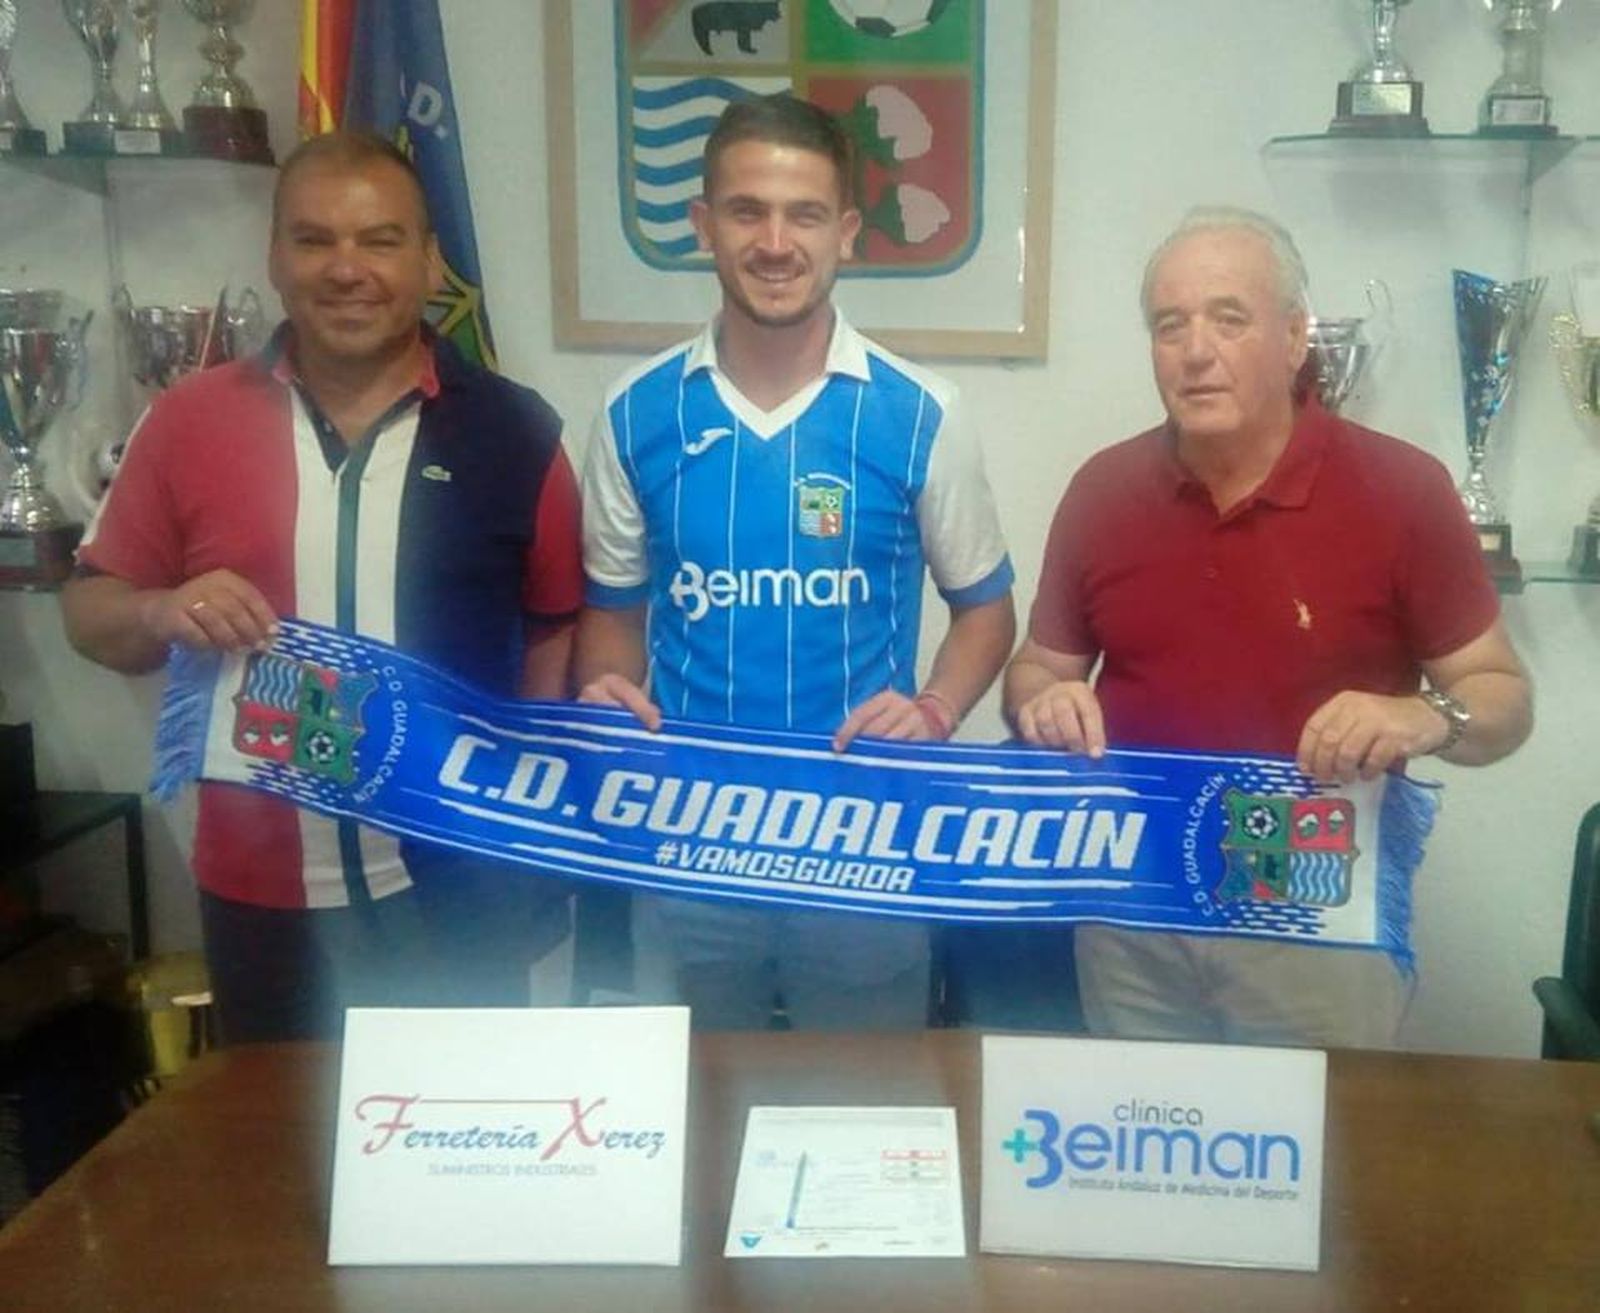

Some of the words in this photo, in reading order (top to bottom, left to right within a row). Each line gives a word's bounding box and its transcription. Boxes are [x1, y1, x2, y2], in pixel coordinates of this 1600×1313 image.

[670, 561, 870, 621] Beiman
[591, 769, 1147, 870] GUADALCACÍN
[654, 839, 917, 893] #VAMOSGUADA
[539, 1096, 668, 1161] Xerez
[1022, 1108, 1300, 1189] Beiman
